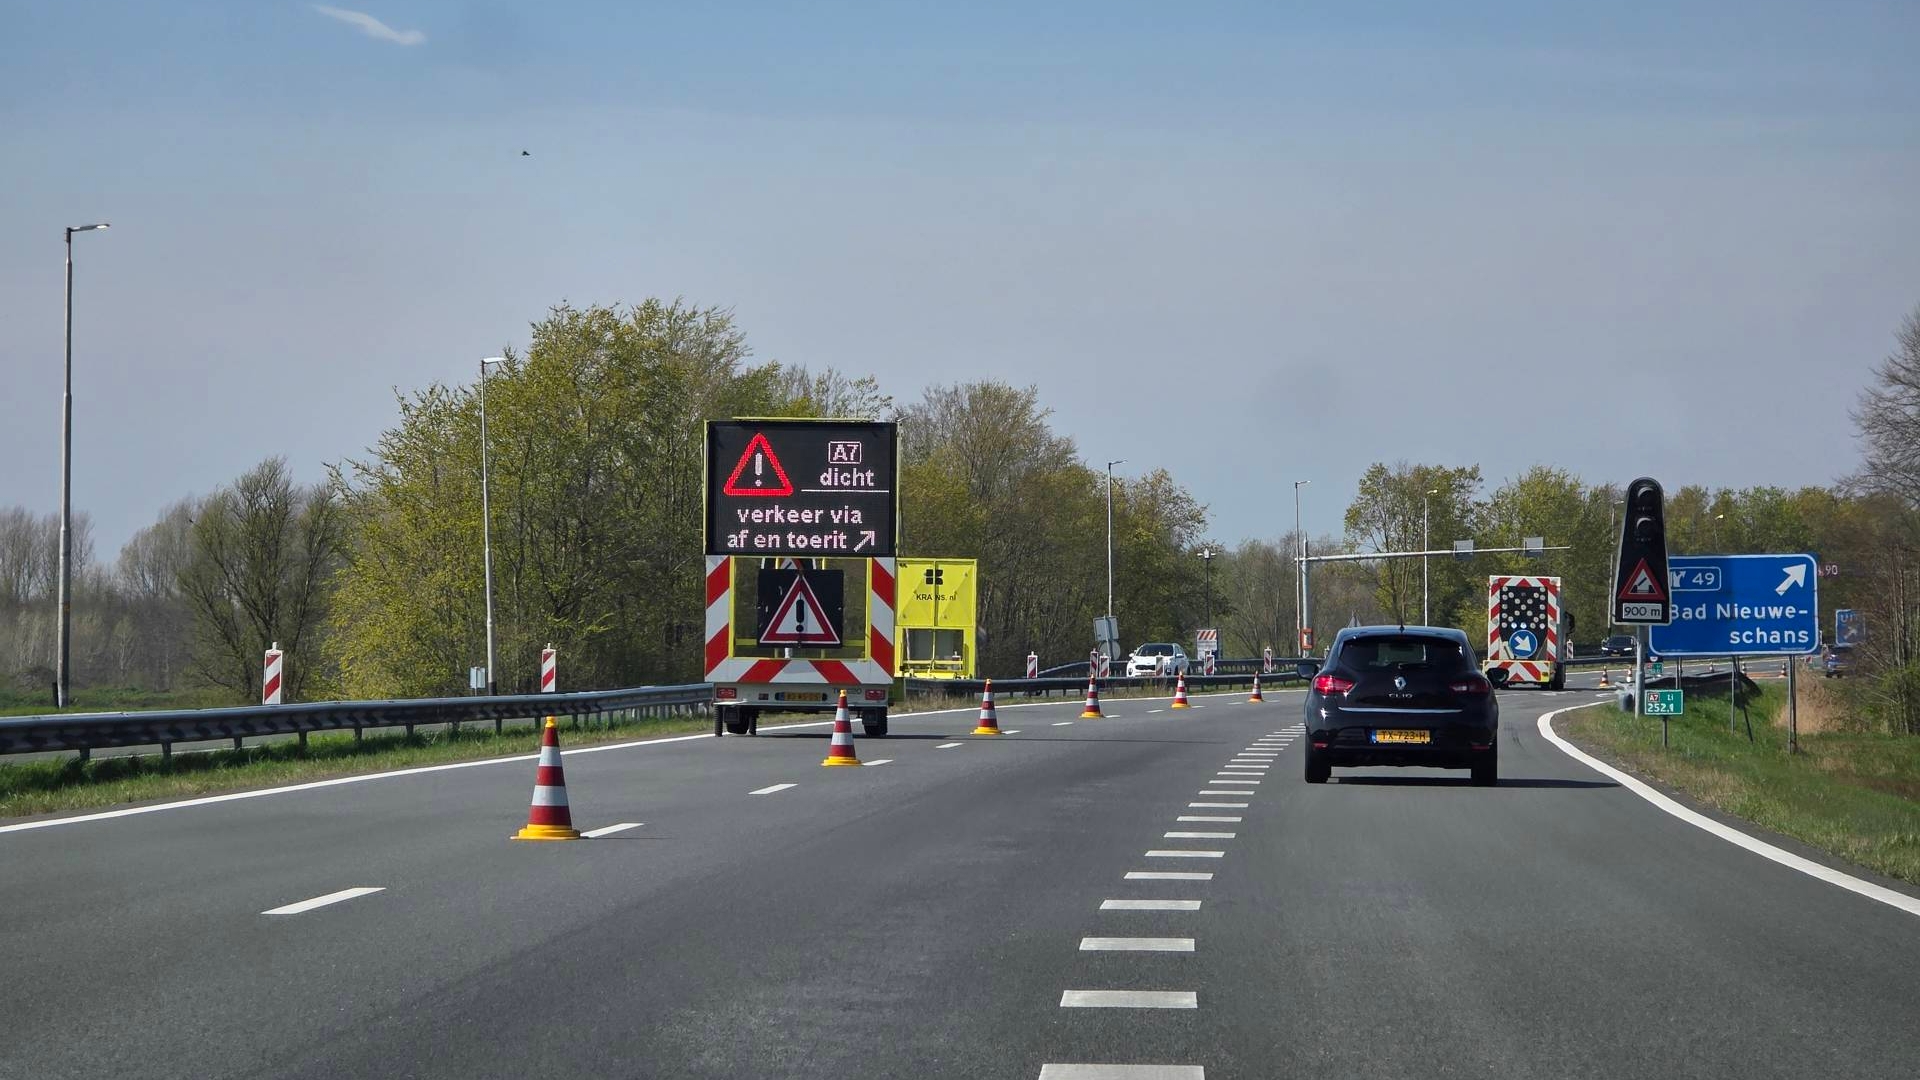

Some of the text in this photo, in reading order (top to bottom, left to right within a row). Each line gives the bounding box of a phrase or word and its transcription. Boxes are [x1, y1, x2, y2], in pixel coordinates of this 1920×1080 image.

[831, 444, 859, 462] A7
[819, 467, 875, 487] dicht
[737, 505, 862, 524] verkeer via
[727, 530, 847, 549] af en toerit
[1692, 572, 1715, 586] 49
[1624, 606, 1661, 616] 900 m
[1670, 602, 1808, 620] Bad Nieuwe-
[1729, 627, 1809, 644] schans
